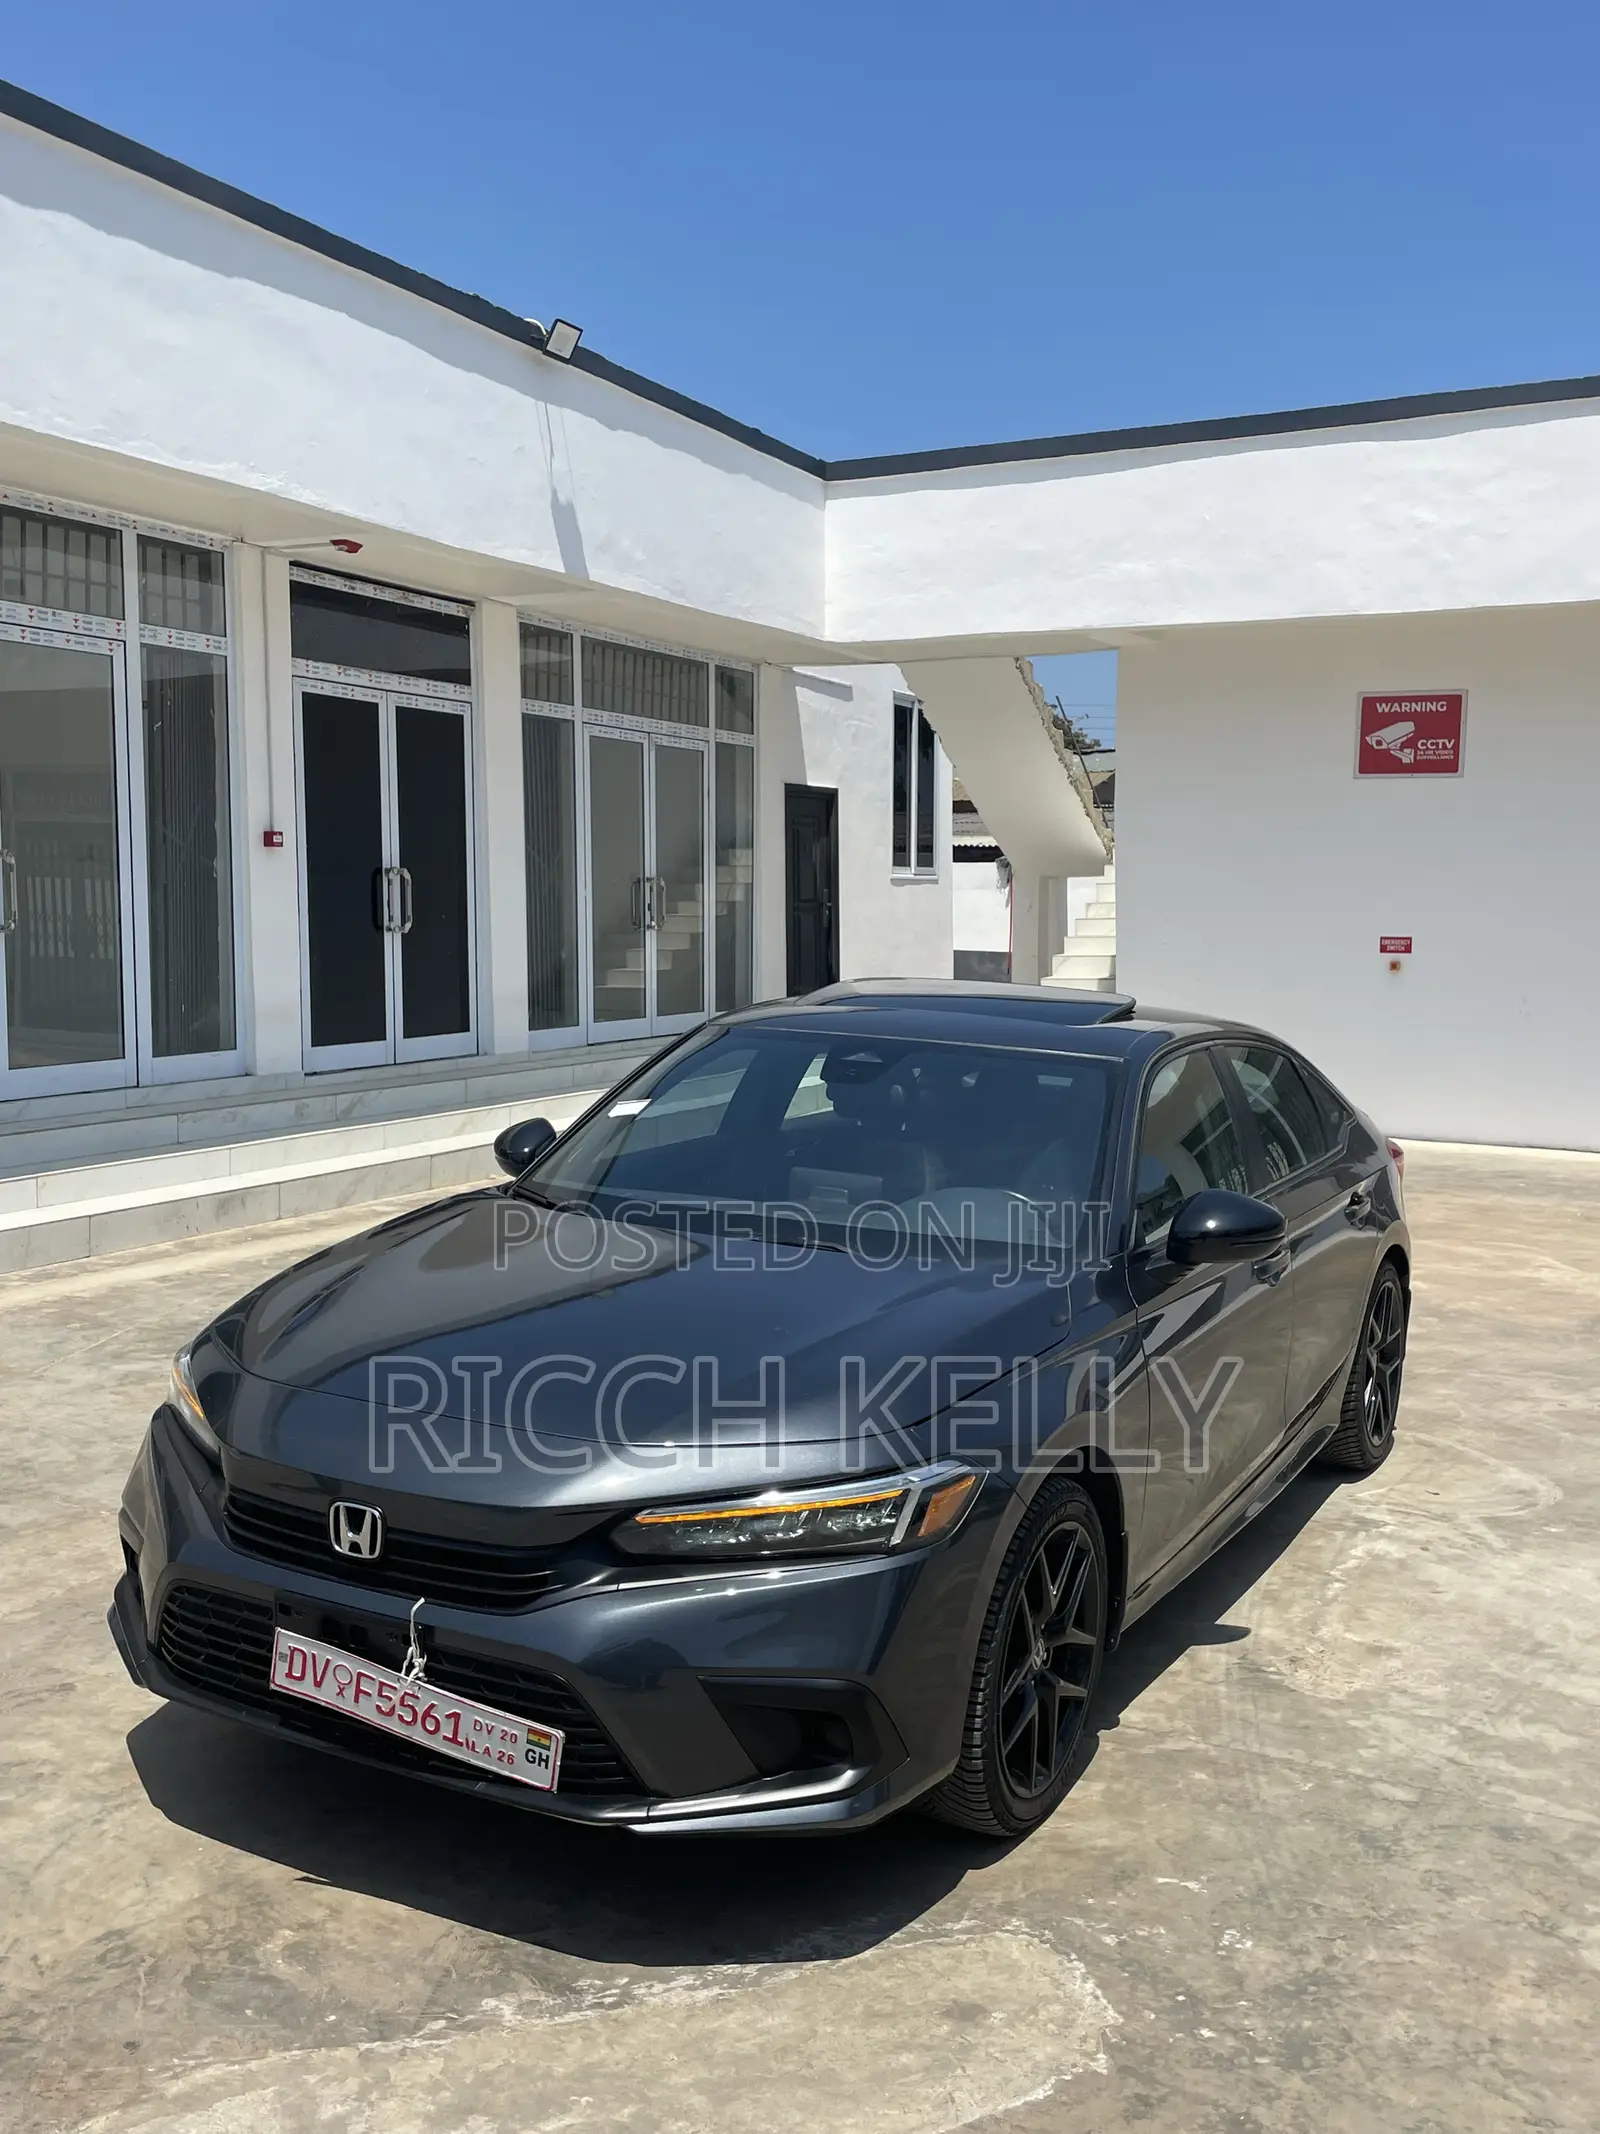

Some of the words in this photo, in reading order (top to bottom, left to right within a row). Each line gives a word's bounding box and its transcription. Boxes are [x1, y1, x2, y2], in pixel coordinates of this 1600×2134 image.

[1376, 701, 1447, 713] WARNING
[1417, 739, 1455, 749] CCTV
[473, 1717, 494, 1736] DV
[499, 1728, 518, 1744] 20
[497, 1749, 515, 1765] 26
[524, 1748, 550, 1770] GH
